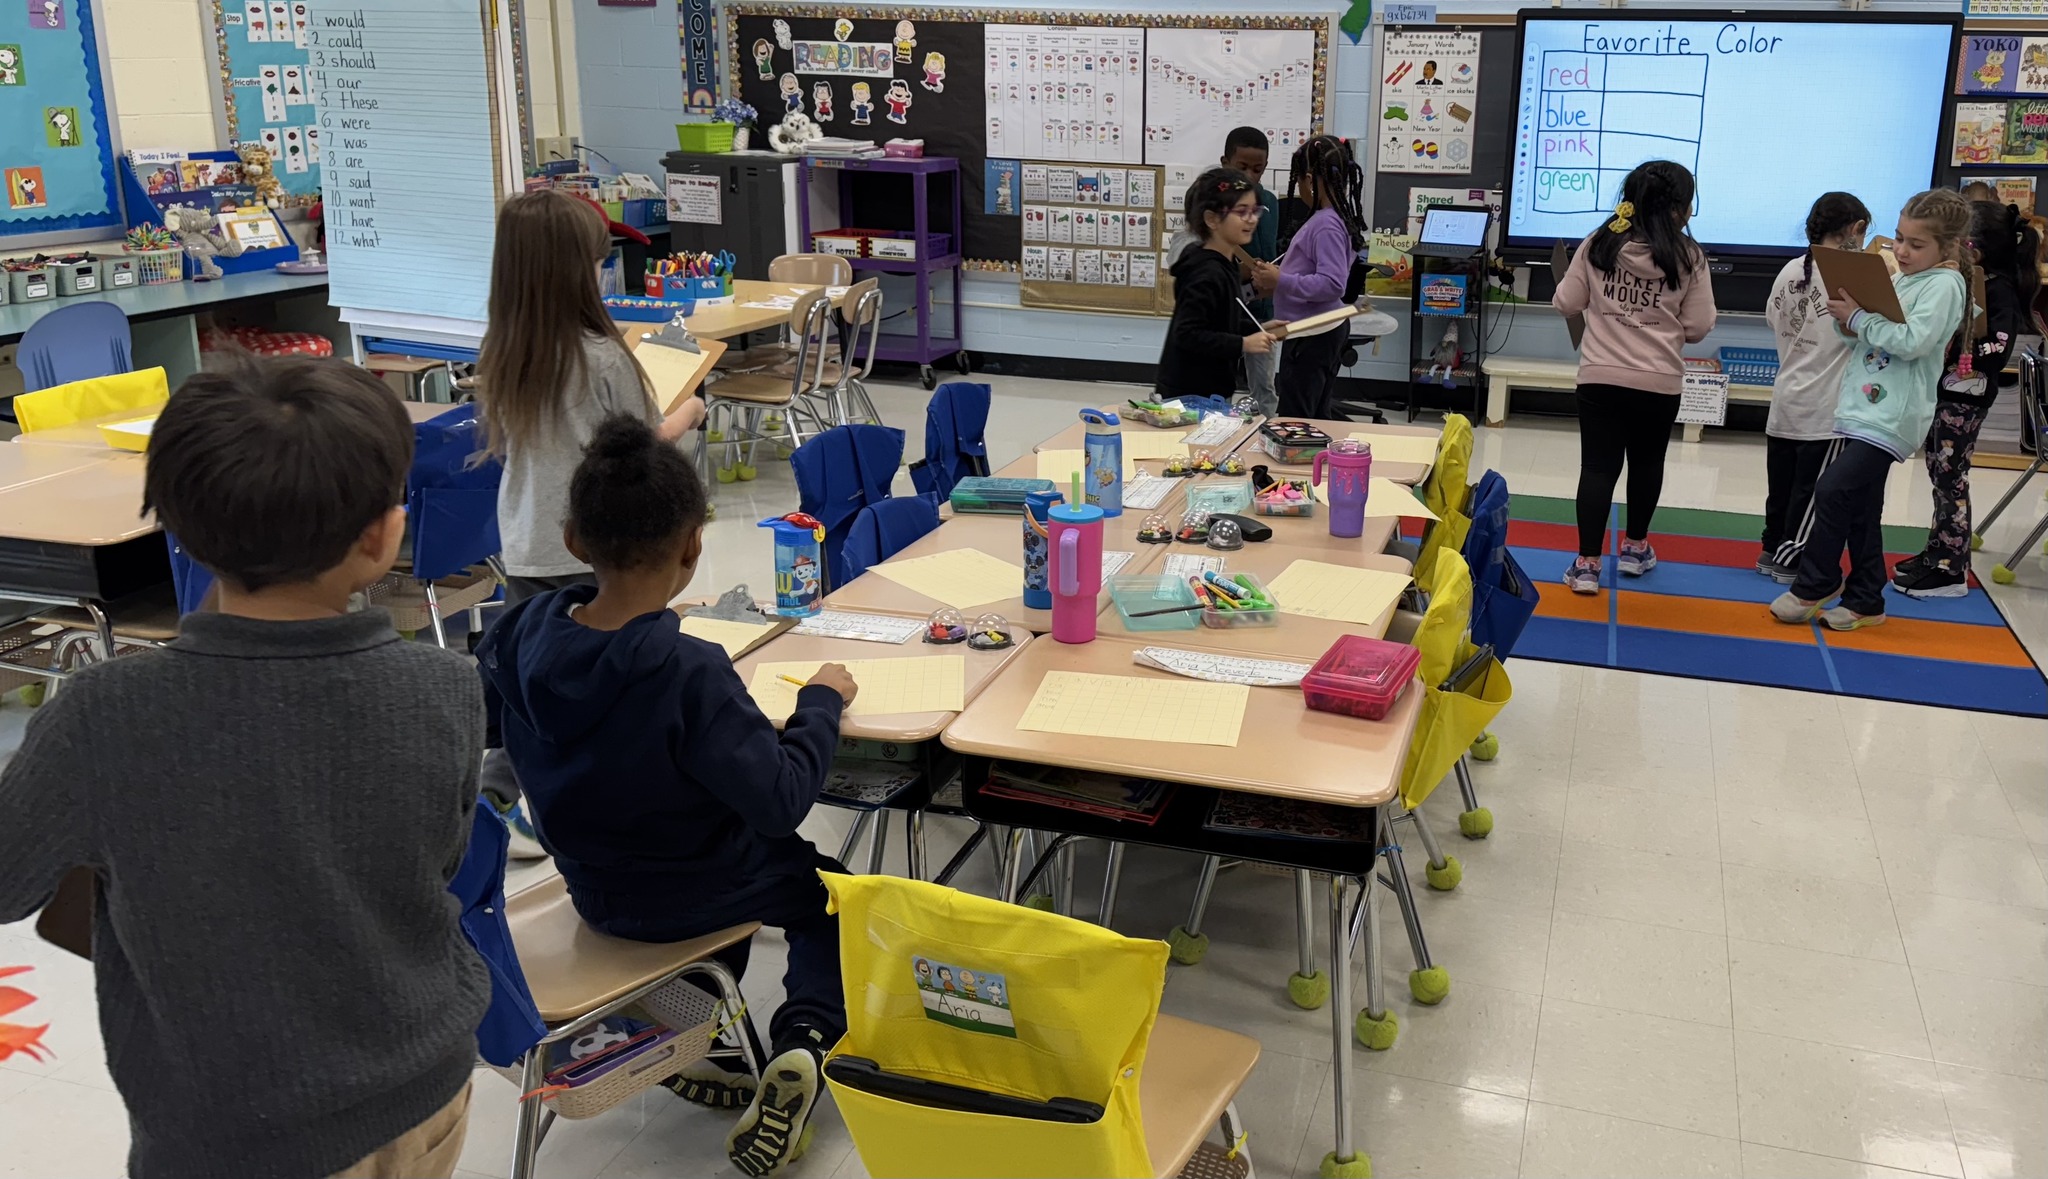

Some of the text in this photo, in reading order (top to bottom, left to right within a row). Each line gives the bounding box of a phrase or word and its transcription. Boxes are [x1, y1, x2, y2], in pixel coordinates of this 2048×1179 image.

[325, 9, 366, 28] would
[328, 30, 363, 49] could
[1406, 41, 1429, 49] January
[1584, 23, 1782, 54] Favorite Color
[1973, 38, 2019, 51] YOKO
[331, 51, 376, 70] should
[794, 42, 891, 71] READING
[1549, 57, 1590, 88] red
[337, 78, 362, 89] our
[339, 91, 379, 110] these
[1546, 92, 1591, 128] blue
[341, 118, 371, 130] were
[344, 137, 368, 148] was
[1545, 132, 1593, 166] pink
[345, 157, 365, 169] are
[349, 171, 371, 189] said
[1103, 172, 1111, 186] b
[1538, 170, 1595, 200] green
[349, 193, 377, 209] want
[1103, 190, 1111, 202] d
[1417, 195, 1454, 204] Shared
[351, 212, 375, 228] have
[352, 232, 382, 248] what
[1376, 238, 1390, 246] The
[1392, 239, 1410, 248] Lost
[836, 248, 856, 256] NOTES
[1602, 267, 1666, 293] MICKEY
[1603, 284, 1661, 309] MOUSE
[1169, 659, 1261, 676] Aria Acevedo
[938, 993, 982, 1023] Aria
